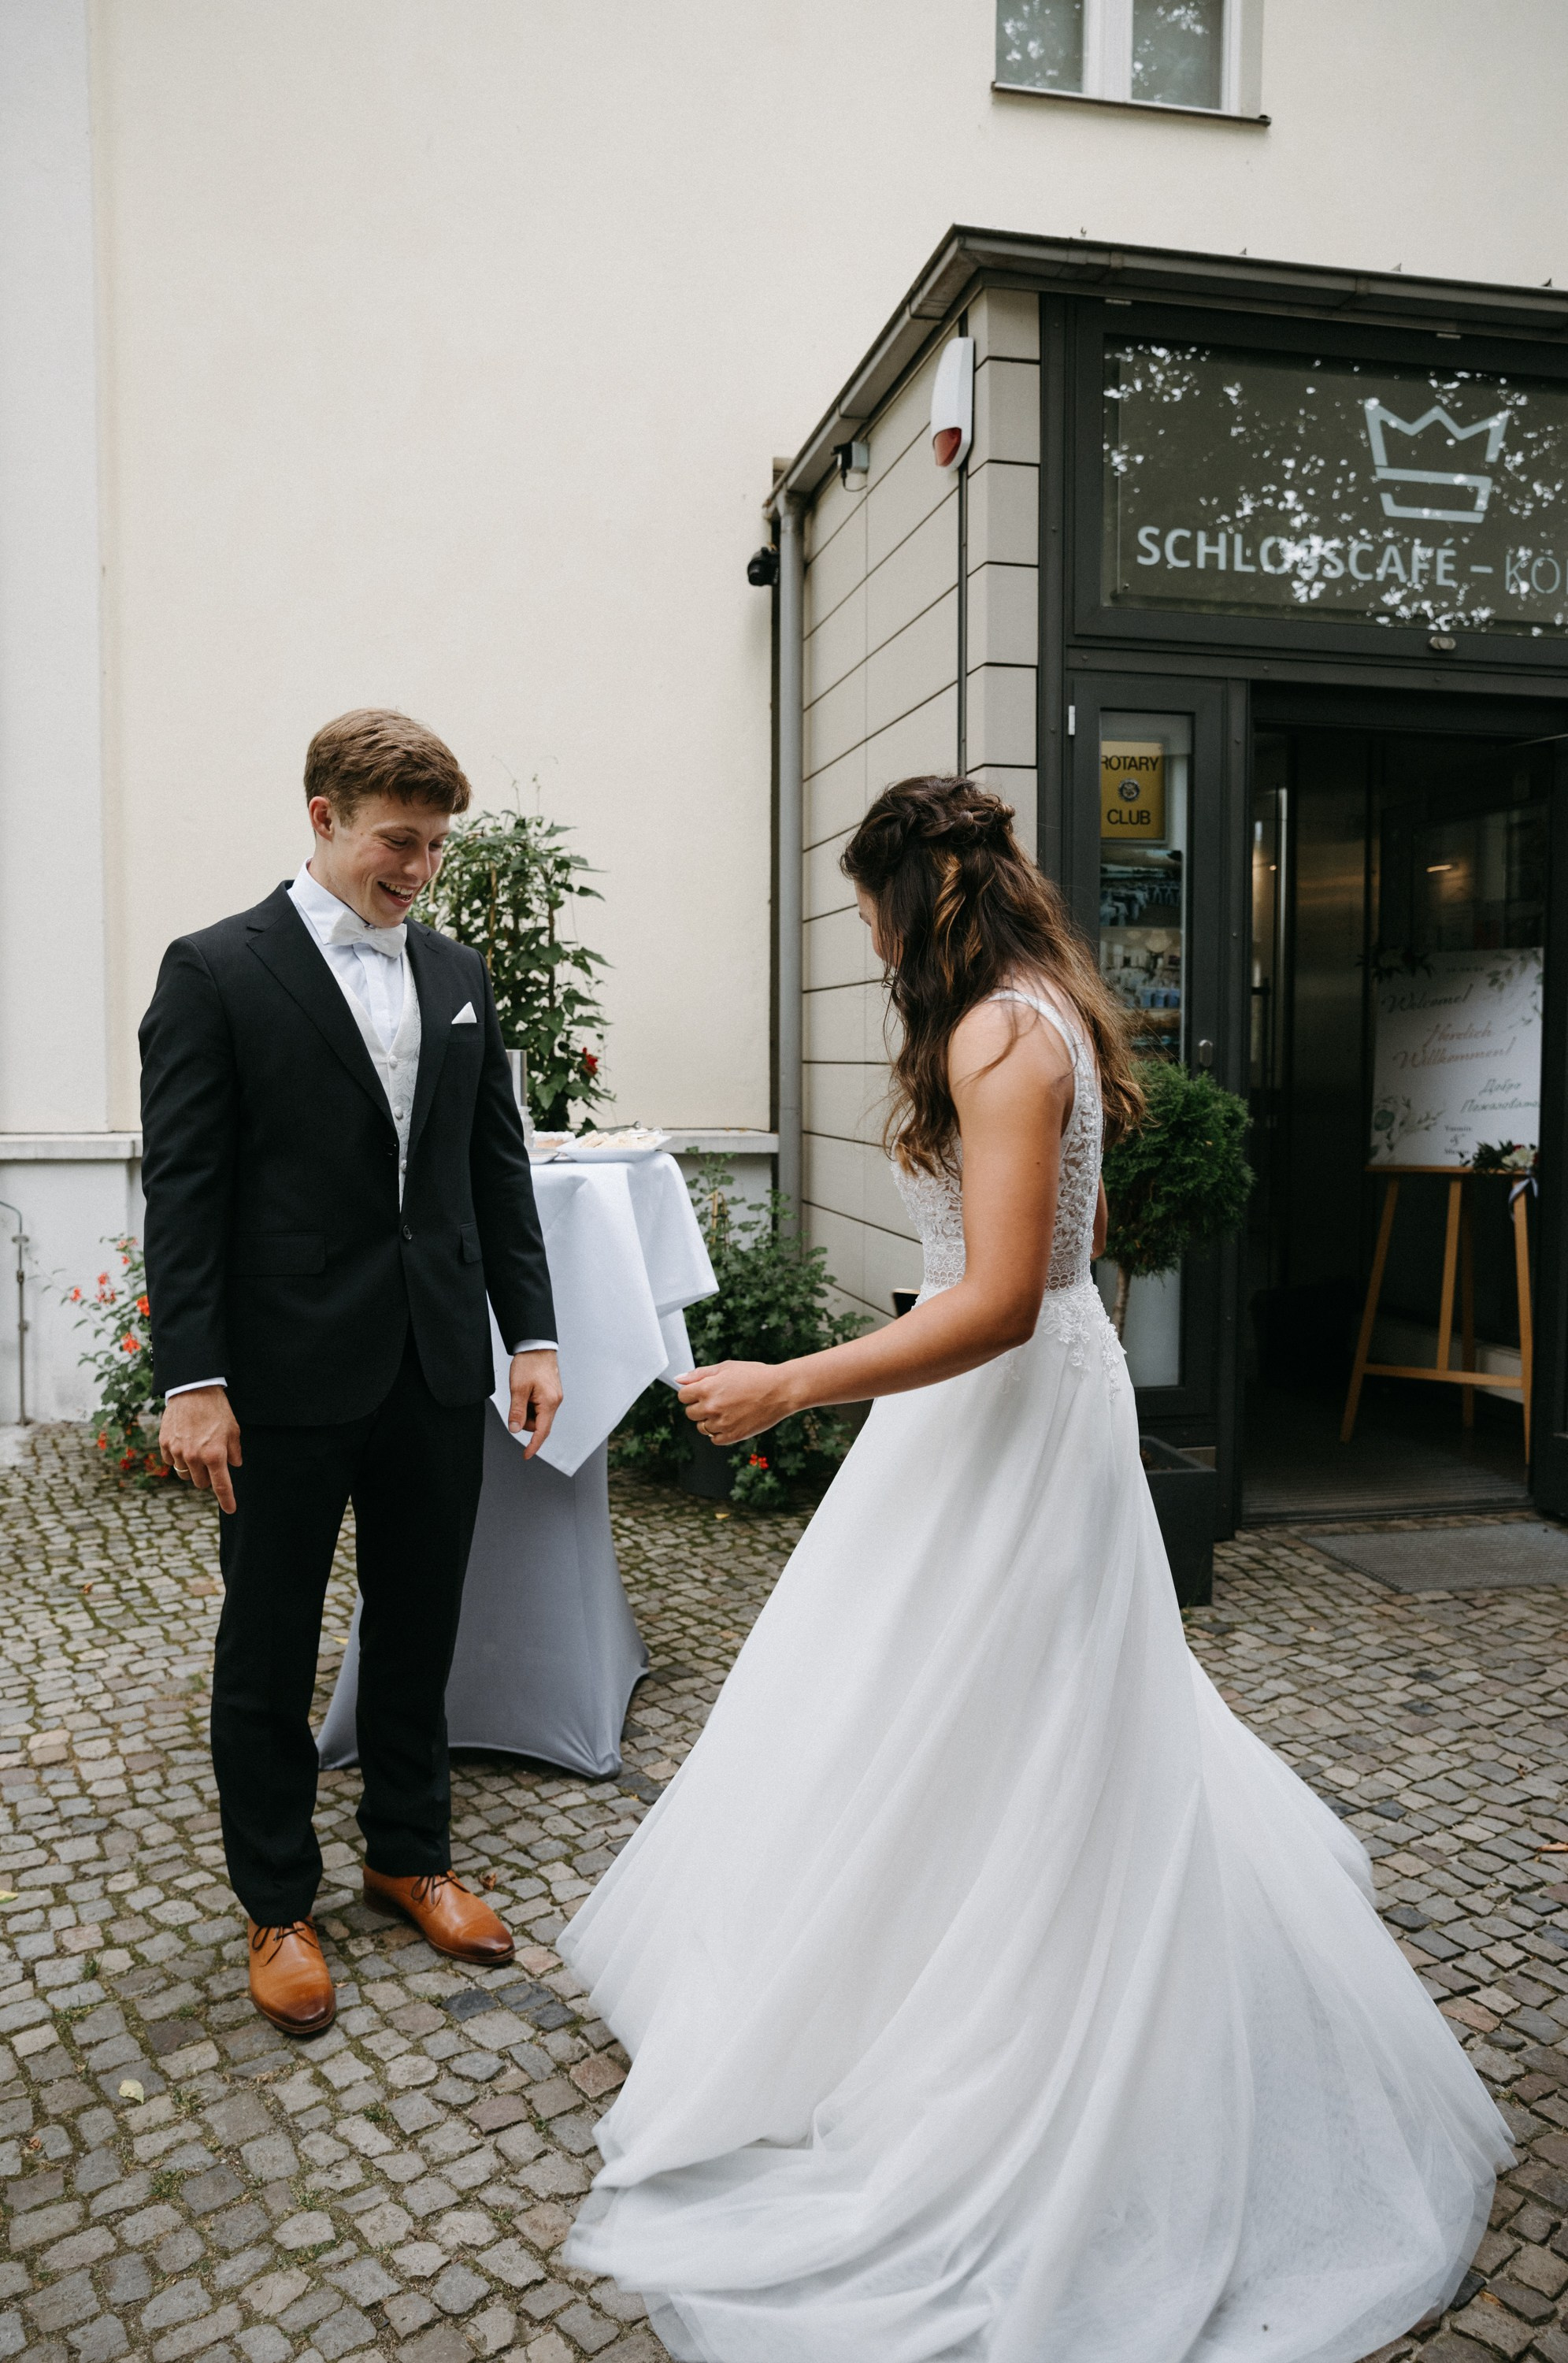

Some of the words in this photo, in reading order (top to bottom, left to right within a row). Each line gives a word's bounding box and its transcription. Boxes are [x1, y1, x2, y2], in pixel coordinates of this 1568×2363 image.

[1101, 756, 1159, 771] ROTARY
[1107, 809, 1151, 825] CLUB
[1381, 983, 1474, 1014] Welcome!
[1392, 1037, 1517, 1070] Willkommen!
